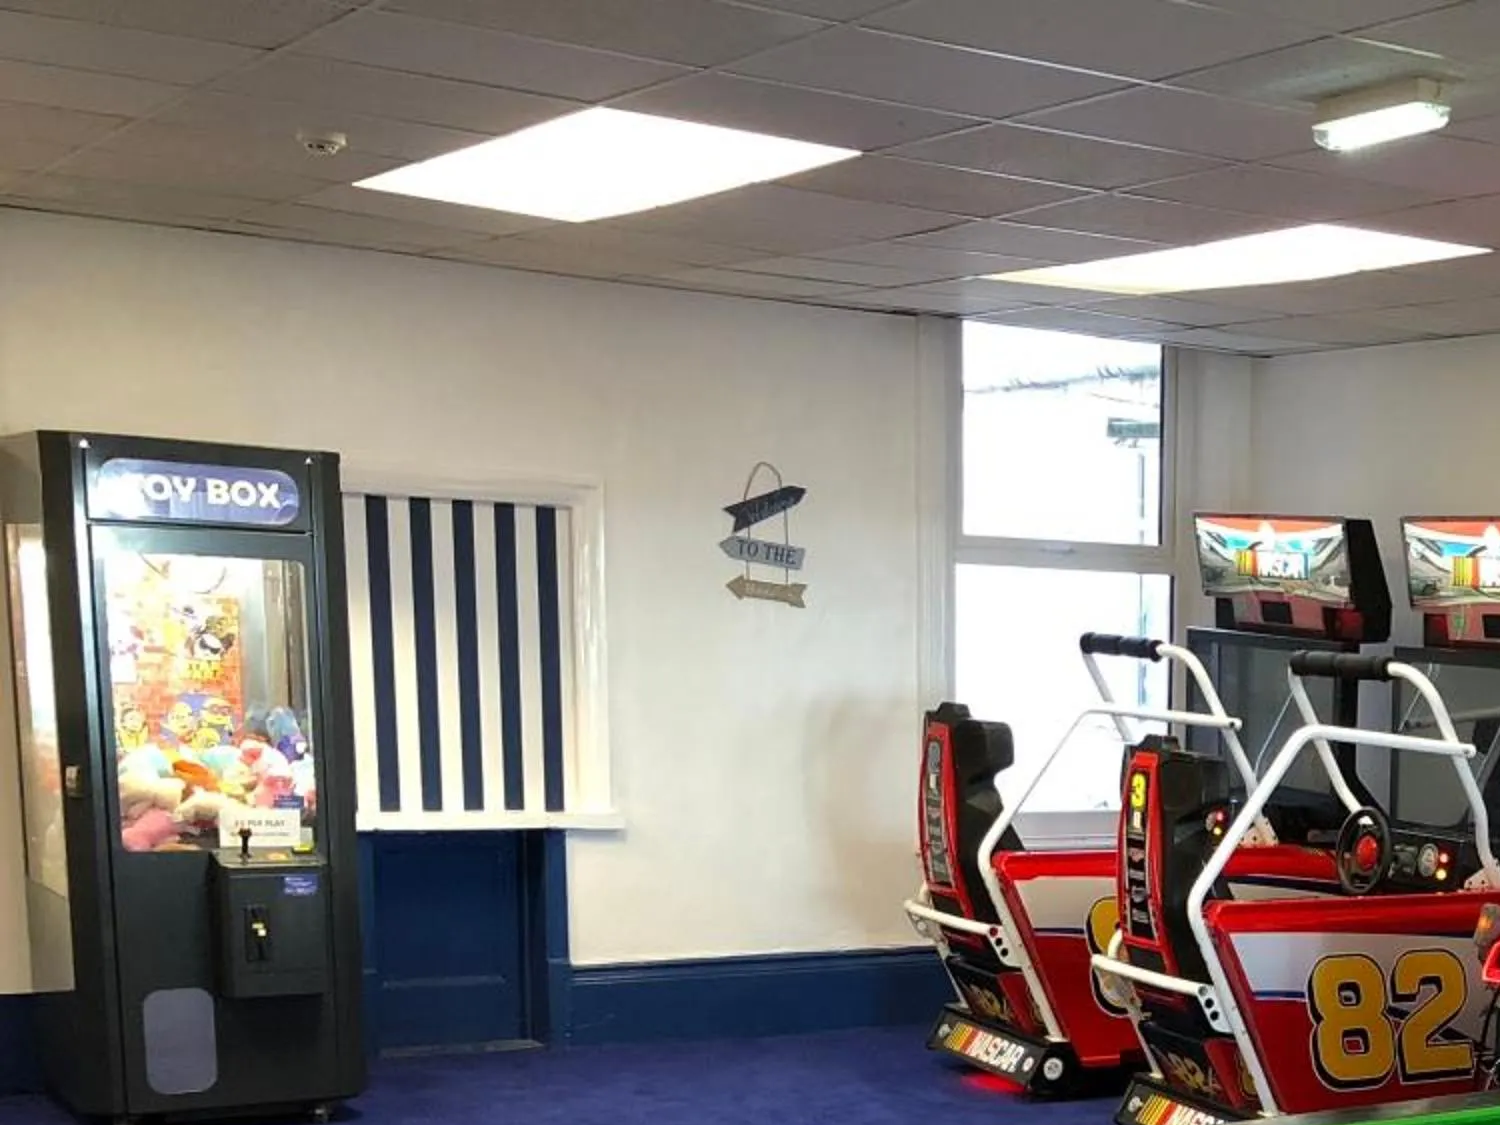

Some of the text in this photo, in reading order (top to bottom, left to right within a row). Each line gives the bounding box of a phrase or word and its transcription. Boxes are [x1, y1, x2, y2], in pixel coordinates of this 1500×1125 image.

[206, 478, 281, 508] BOX
[736, 540, 797, 565] TO THE
[1307, 948, 1476, 1092] 82
[965, 1030, 1026, 1073] NASCAR
